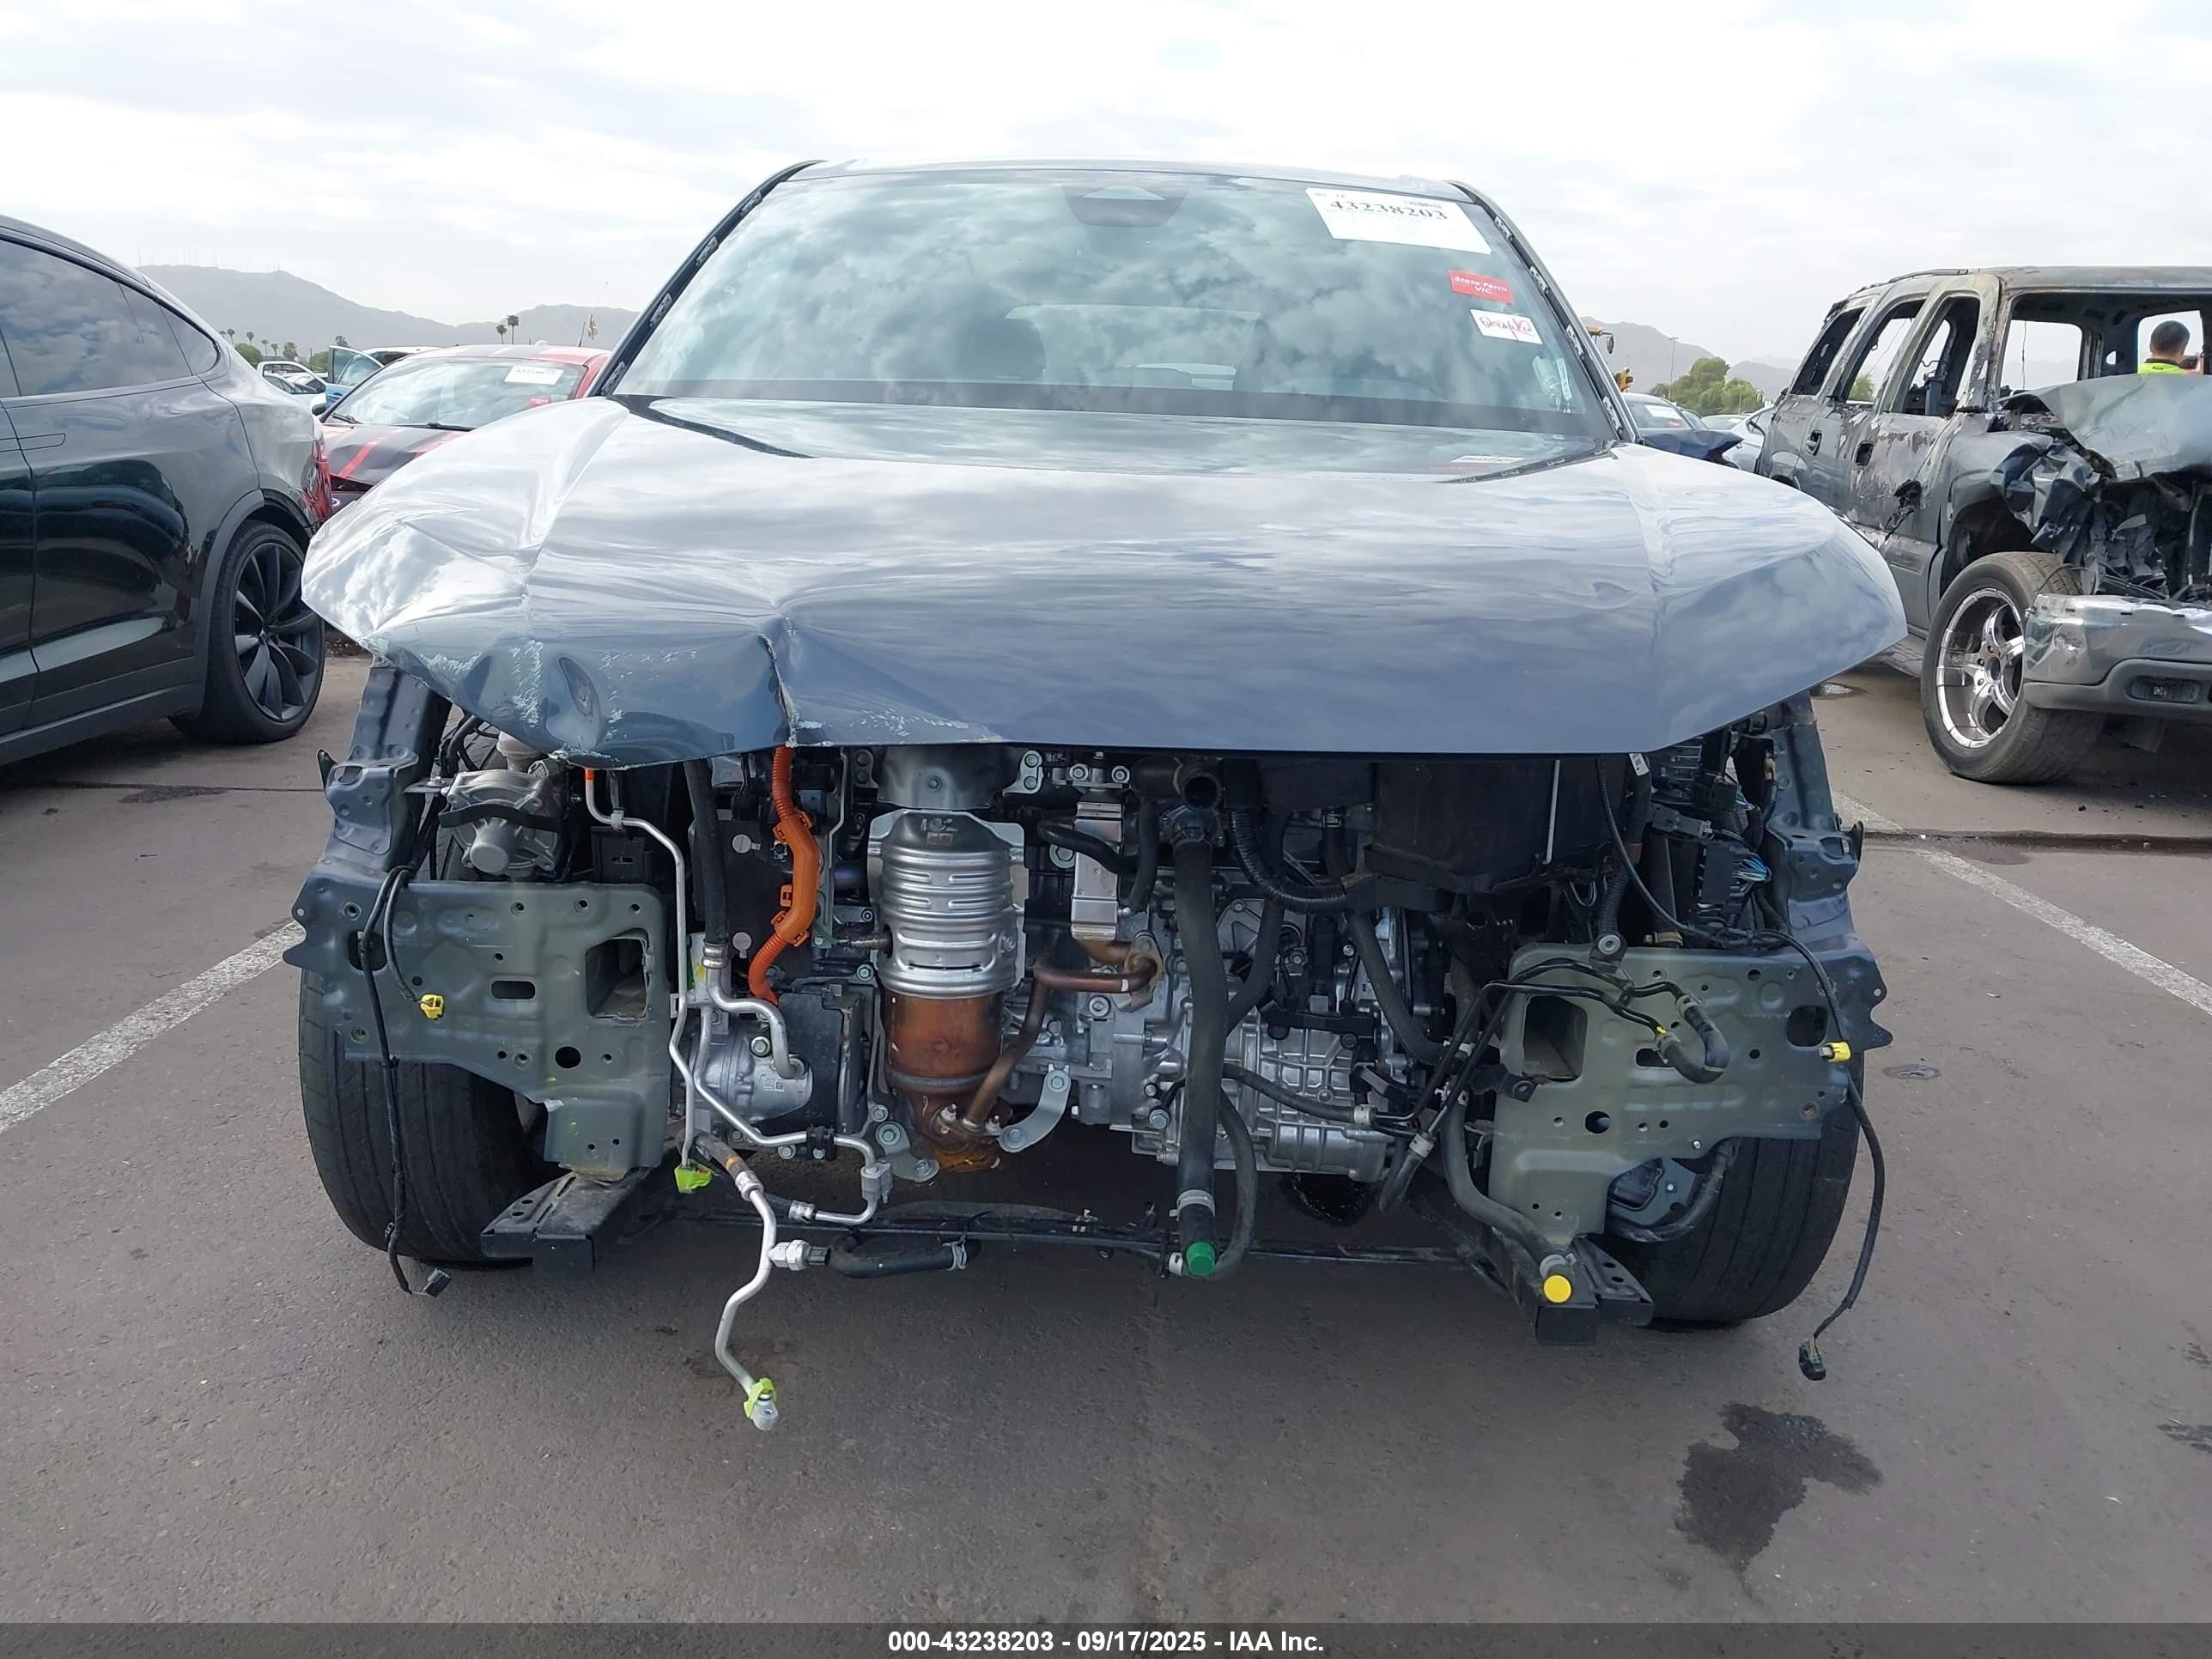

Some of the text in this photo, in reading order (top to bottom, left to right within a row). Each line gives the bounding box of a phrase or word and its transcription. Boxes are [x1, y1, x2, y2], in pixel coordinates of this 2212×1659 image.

[1329, 200, 1448, 220] 43238203
[1454, 276, 1508, 292] State Farm
